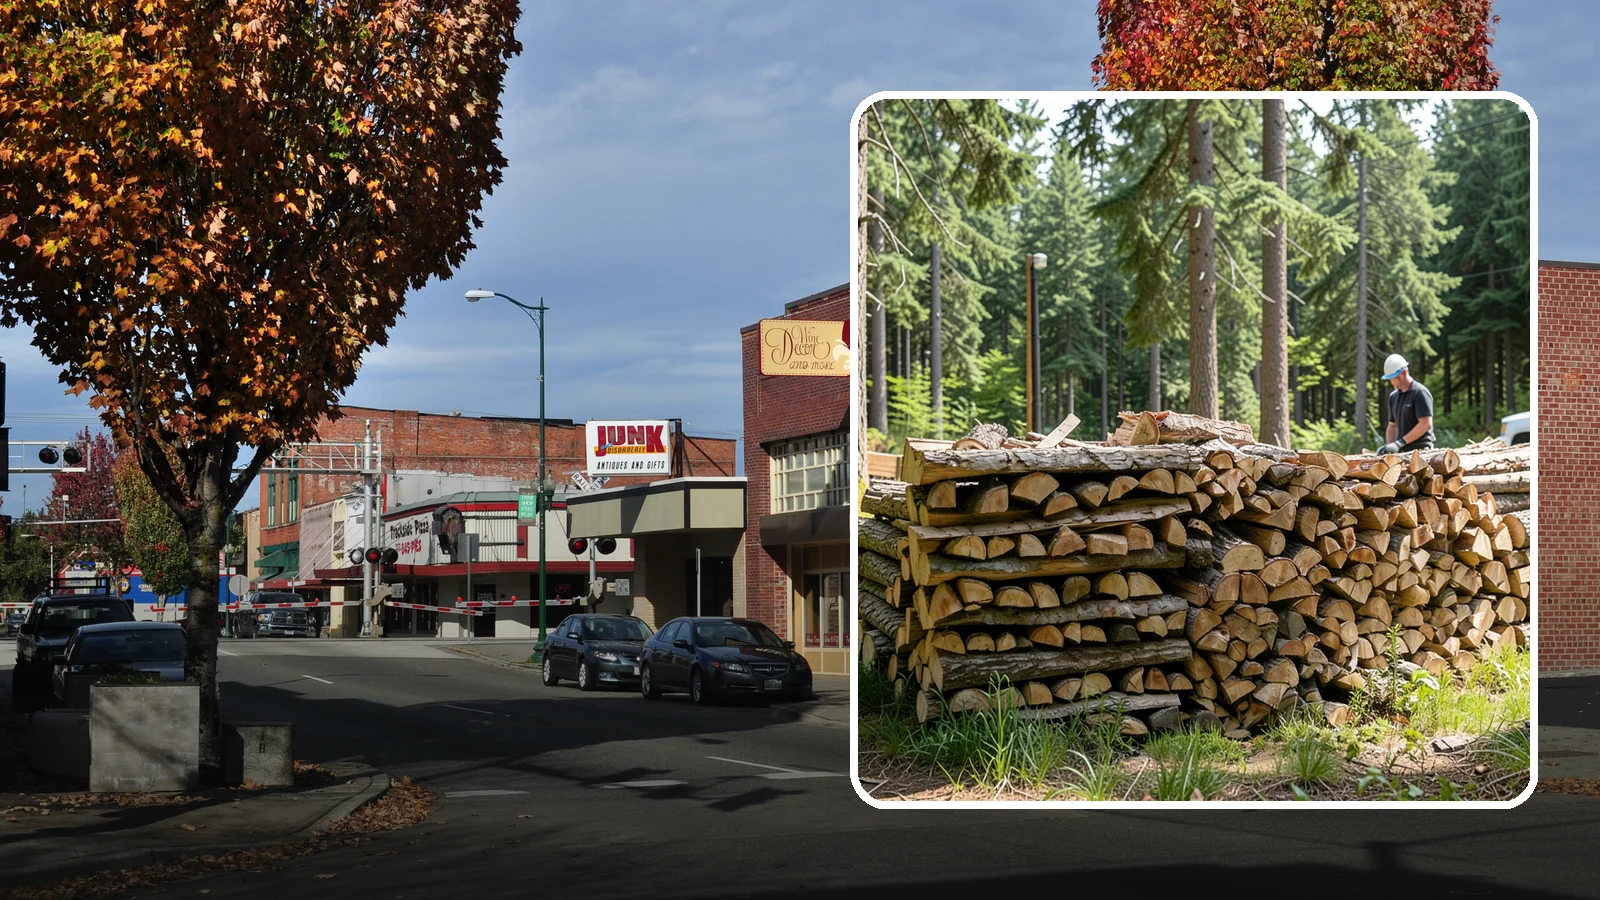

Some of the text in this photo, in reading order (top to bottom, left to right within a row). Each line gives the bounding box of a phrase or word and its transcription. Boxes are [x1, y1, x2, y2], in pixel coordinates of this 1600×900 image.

[595, 425, 665, 457] JUNK
[607, 446, 646, 454] DISORDERLY
[596, 460, 665, 470] ANTIQUES AND GIFTS
[414, 519, 429, 535] Pizza
